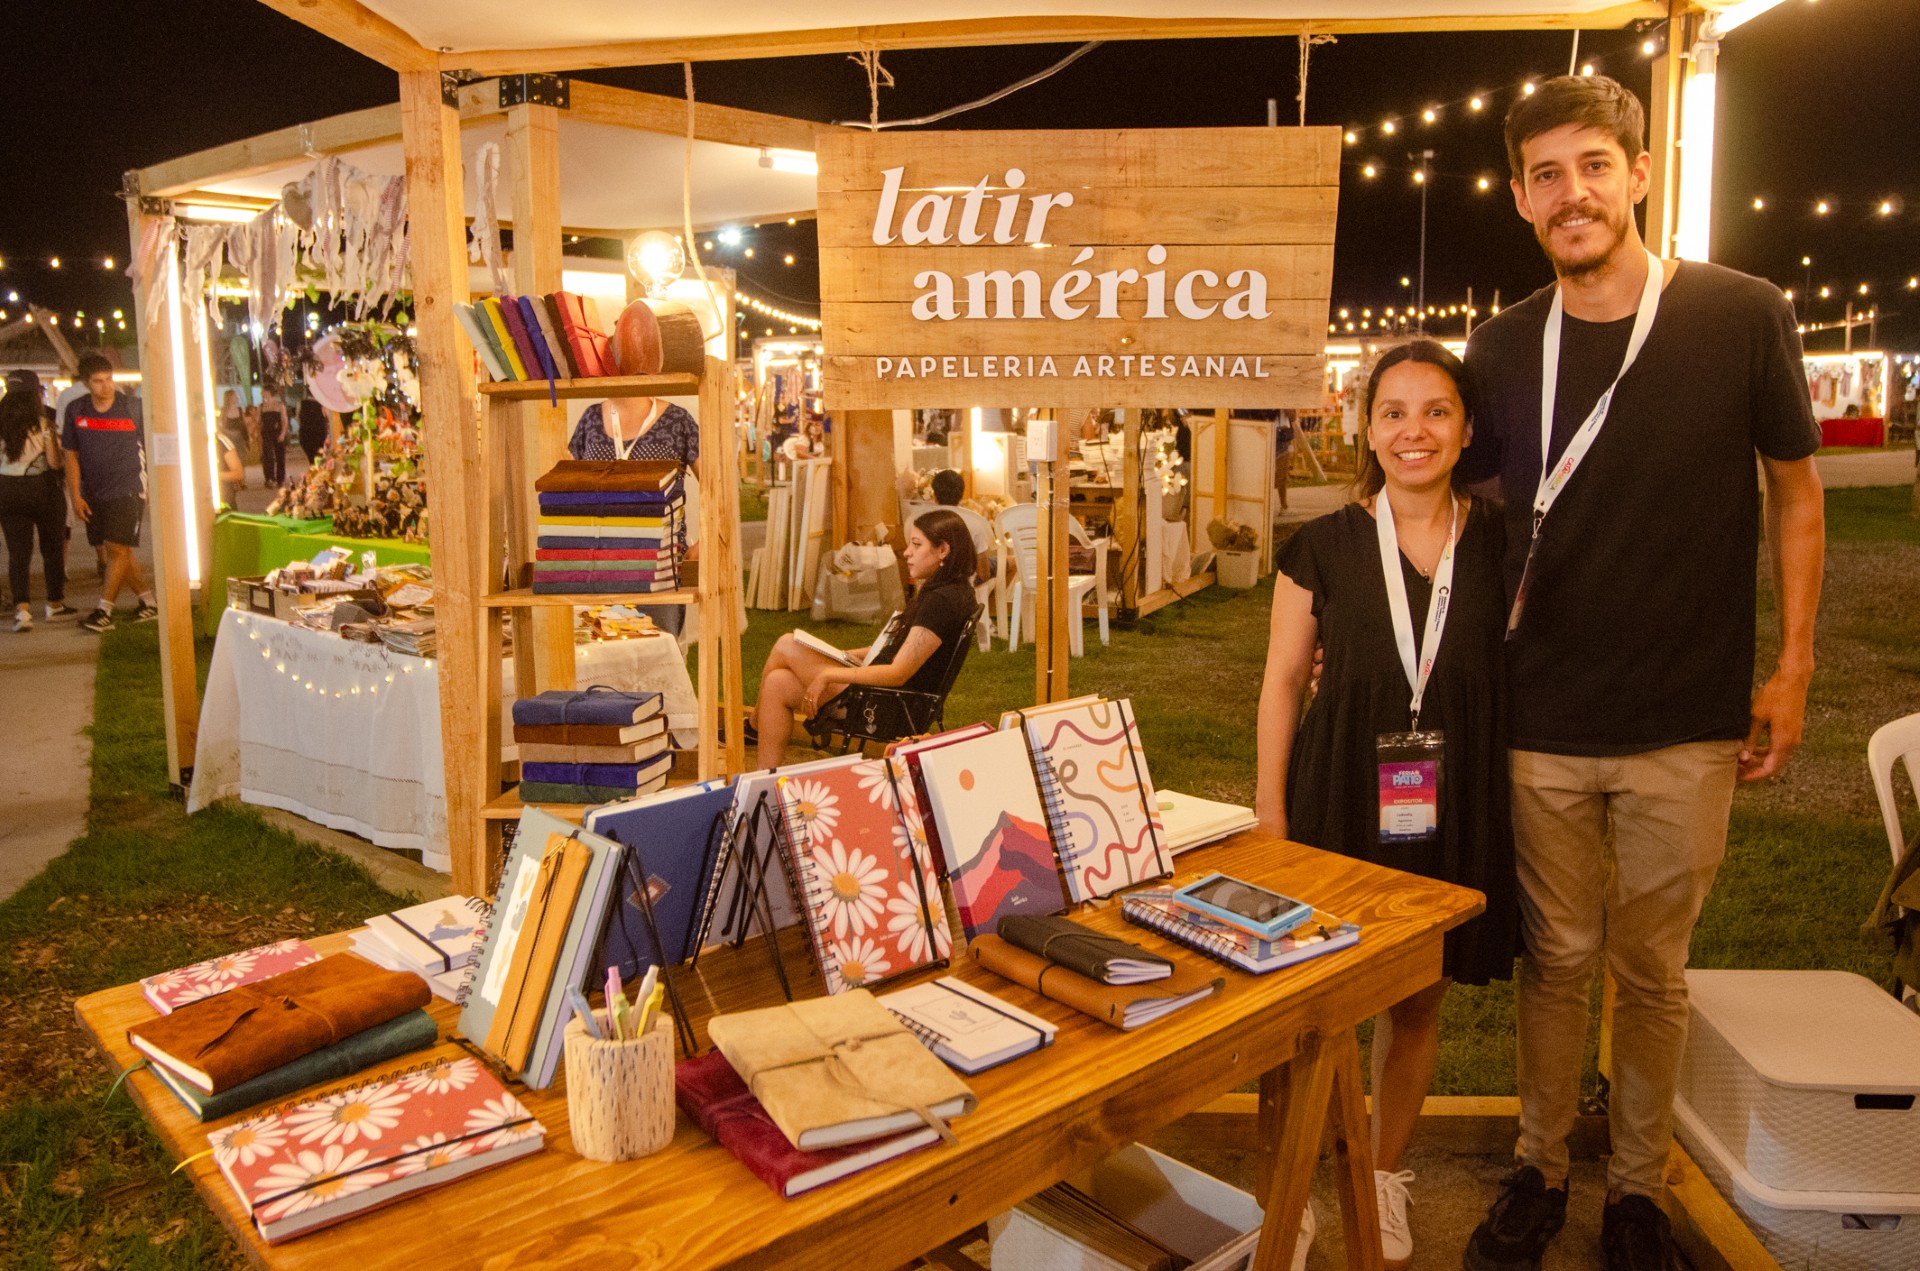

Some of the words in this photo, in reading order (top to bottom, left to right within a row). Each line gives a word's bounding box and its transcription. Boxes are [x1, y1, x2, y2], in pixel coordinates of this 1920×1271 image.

[872, 166, 1074, 246] latir
[911, 244, 1273, 321] américa
[876, 355, 1058, 379] PAPELERIA
[1072, 354, 1270, 378] ARTESANAL
[1393, 774, 1423, 786] PATIO
